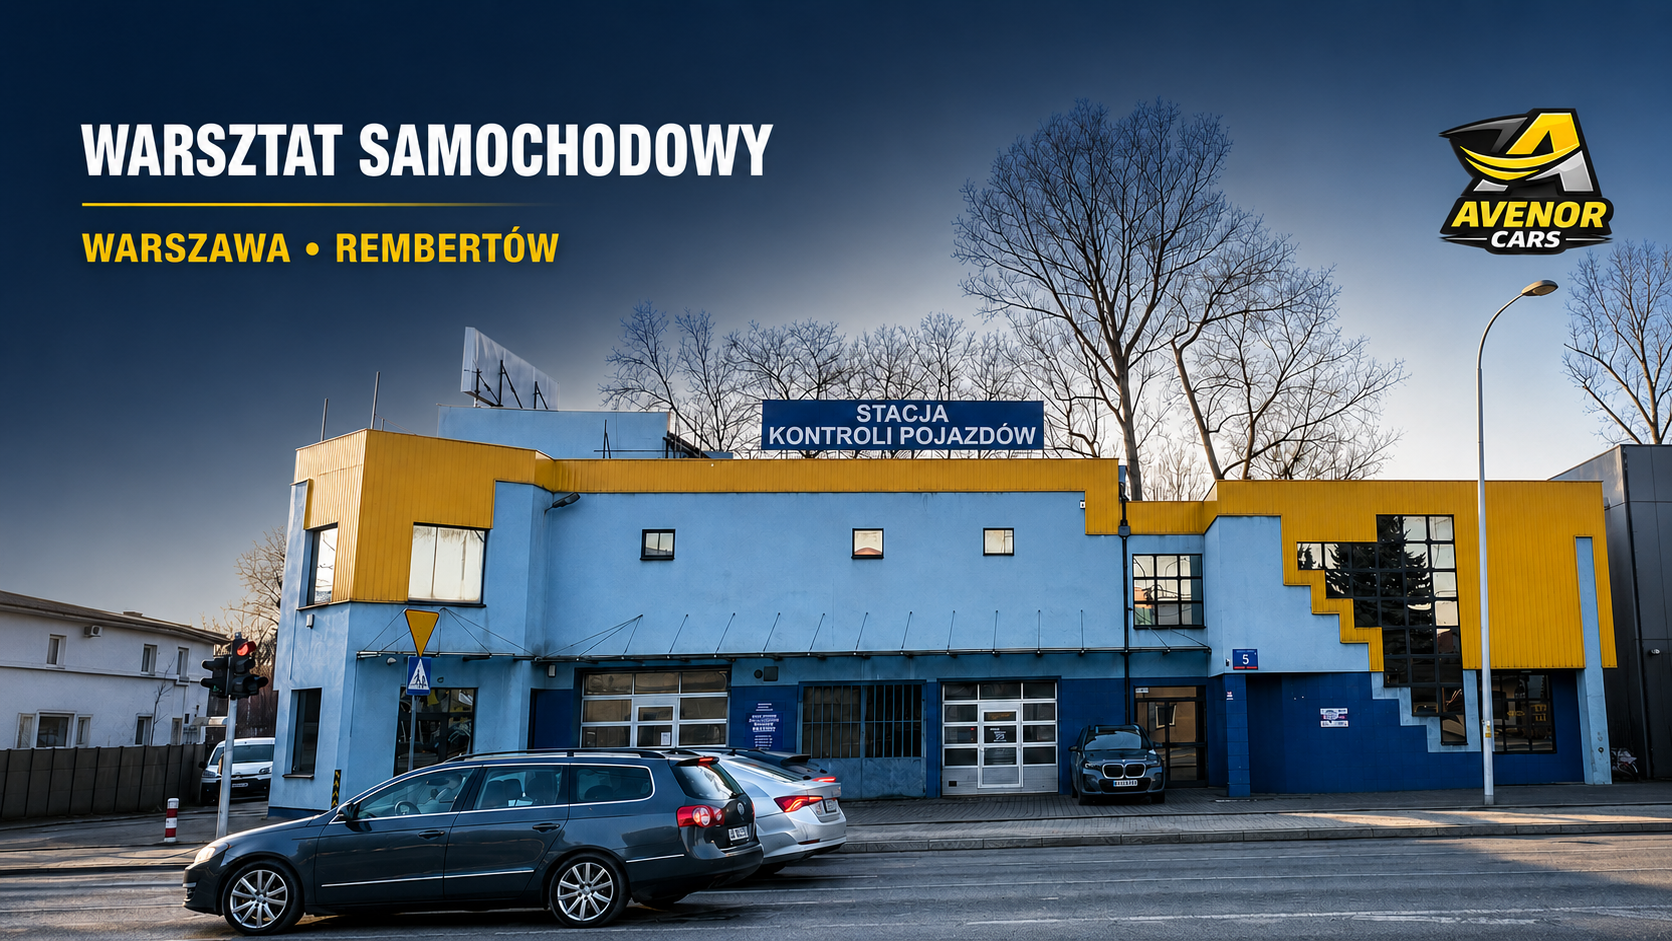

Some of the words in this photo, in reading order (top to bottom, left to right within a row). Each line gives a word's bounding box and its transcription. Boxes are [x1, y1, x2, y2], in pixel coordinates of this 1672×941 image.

[856, 404, 949, 423] STACJA
[769, 426, 892, 445] KONTROLI
[900, 422, 1036, 445] POJAZDÓW
[1242, 654, 1249, 665] 5
